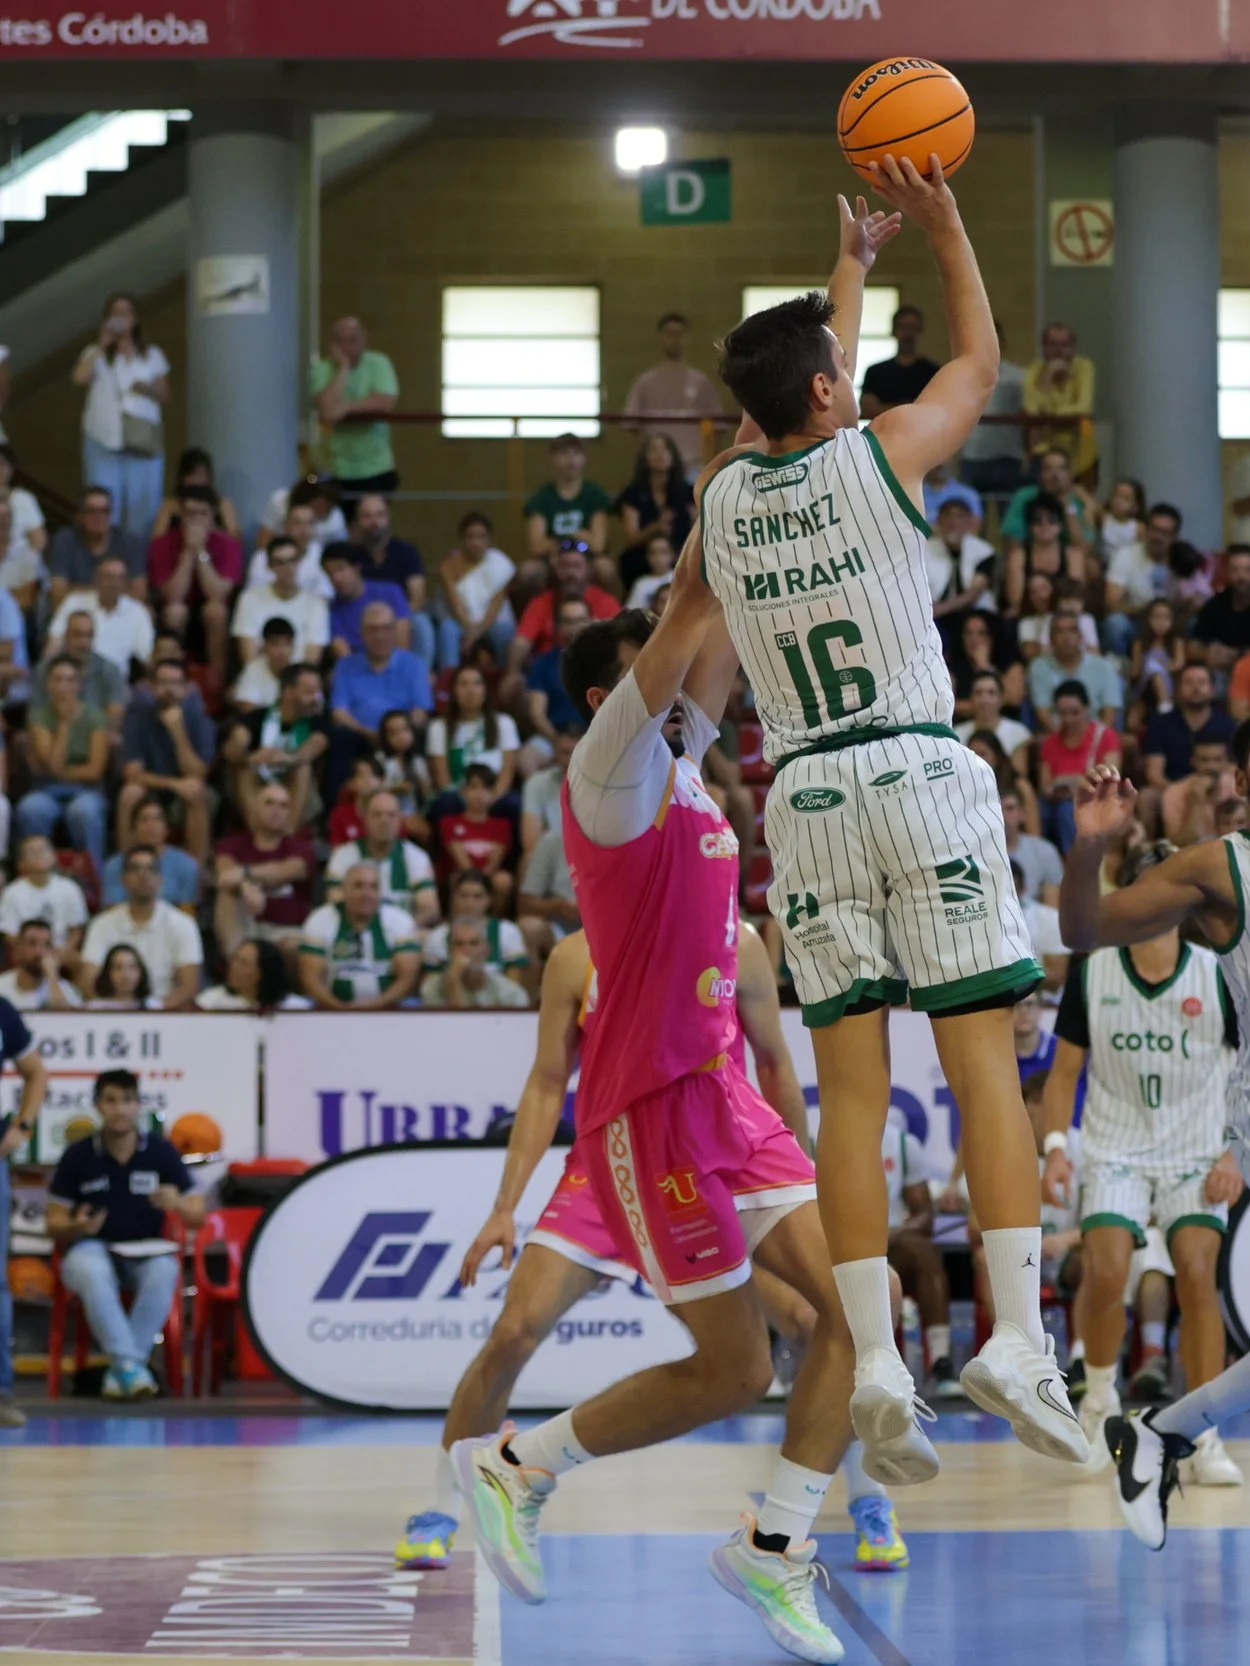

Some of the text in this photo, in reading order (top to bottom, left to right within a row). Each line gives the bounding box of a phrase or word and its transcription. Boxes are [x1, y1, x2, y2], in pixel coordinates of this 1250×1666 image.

[57, 12, 209, 45] Córdoba
[852, 59, 937, 100] Wilson
[666, 170, 705, 216] D
[734, 493, 842, 549] SANCHEZ
[784, 547, 866, 595] RAHI
[748, 589, 839, 612] SOLUCIONES INTEGRALES
[781, 619, 878, 729] 16
[924, 758, 953, 775] PRO
[797, 791, 832, 808] Ford
[875, 781, 908, 800] TYSA
[945, 902, 987, 917] REALE
[947, 912, 989, 925] SEGUROS
[794, 920, 830, 941] Hospital
[105, 1032, 129, 1058] &
[1111, 1030, 1174, 1052] coto
[1139, 1074, 1161, 1108] 10
[555, 1317, 644, 1345] guros
[145, 1554, 424, 1648] IMDECO
